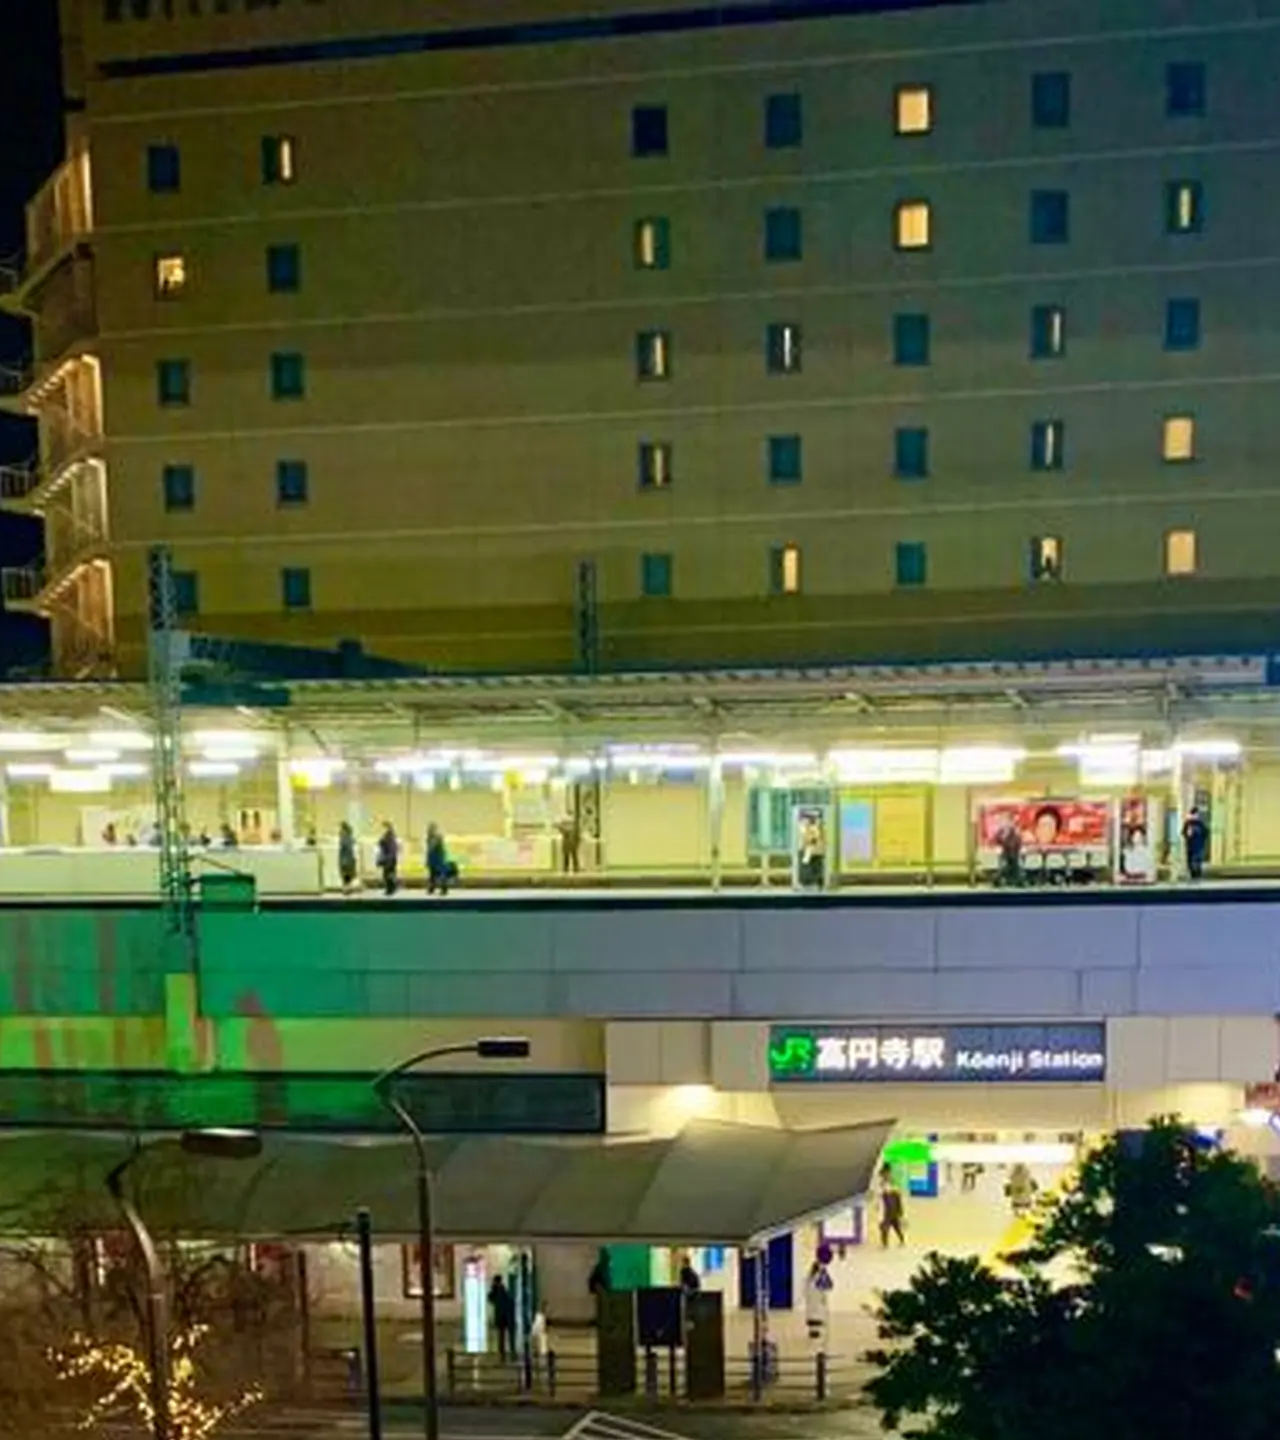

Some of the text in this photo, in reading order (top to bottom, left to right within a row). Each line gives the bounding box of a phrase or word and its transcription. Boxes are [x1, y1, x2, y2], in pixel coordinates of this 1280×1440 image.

[771, 1036, 811, 1069] JR
[816, 1036, 945, 1070] 高円寺駅
[1029, 1049, 1104, 1069] Station
